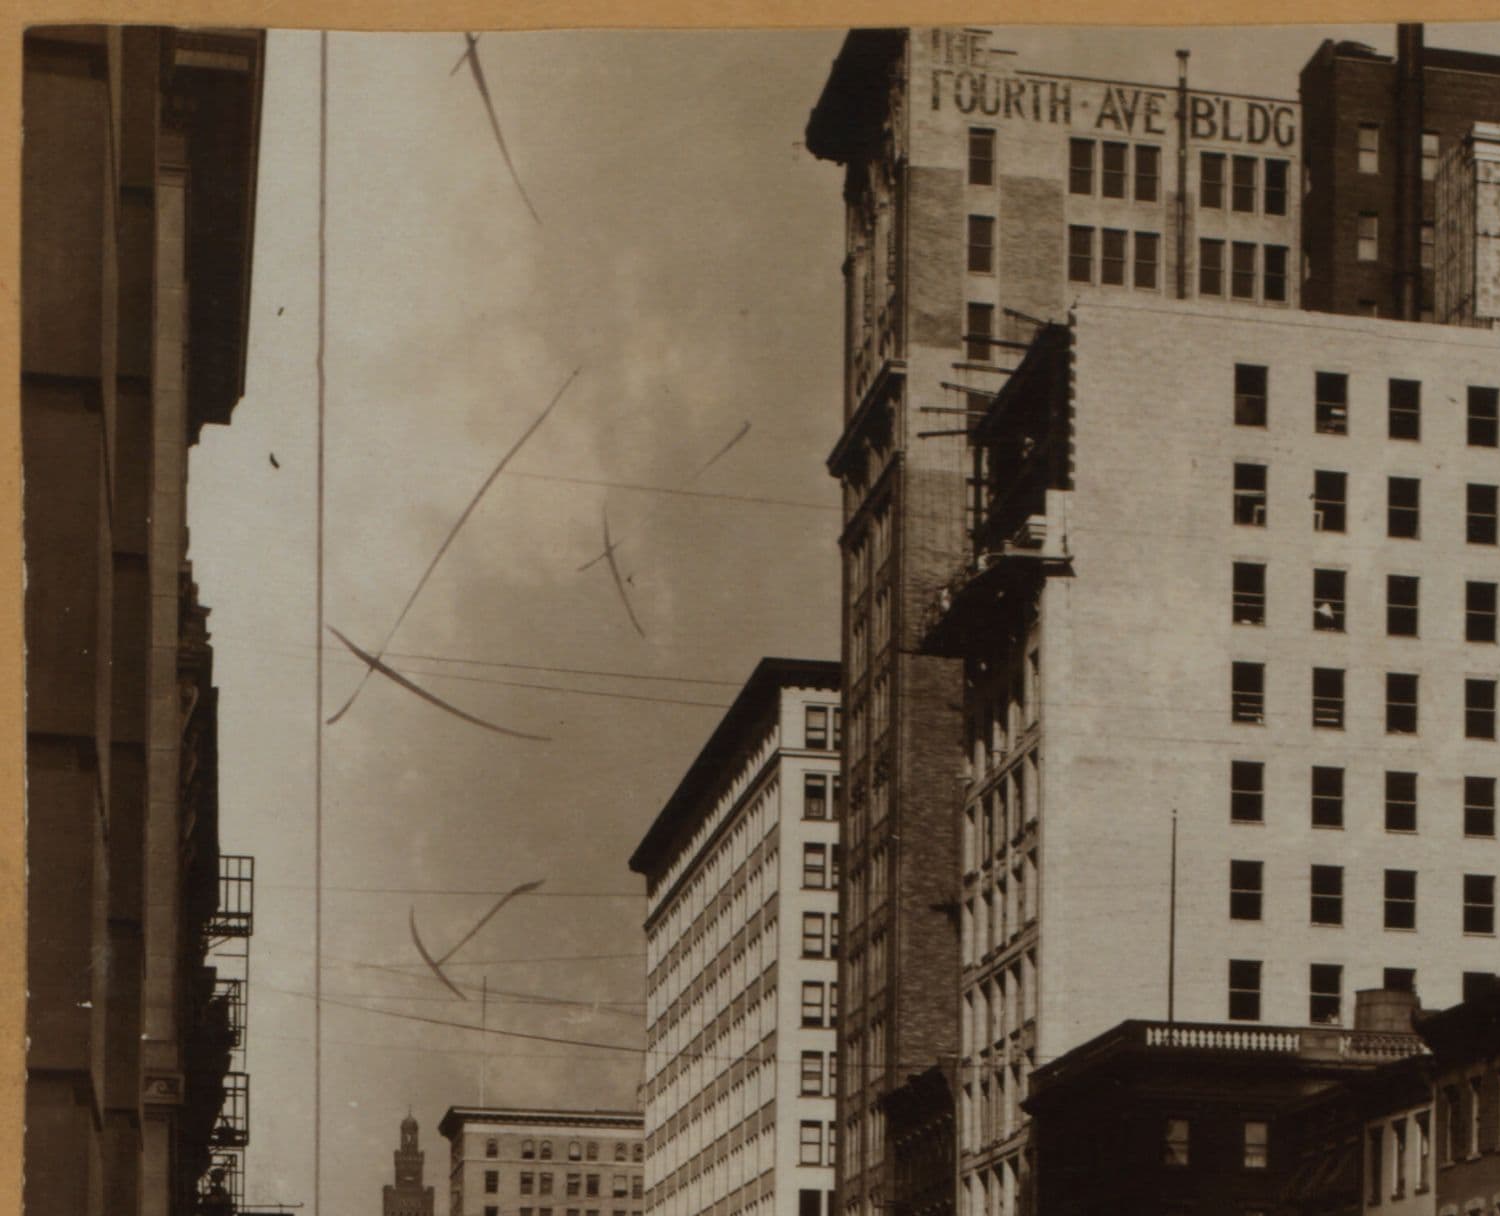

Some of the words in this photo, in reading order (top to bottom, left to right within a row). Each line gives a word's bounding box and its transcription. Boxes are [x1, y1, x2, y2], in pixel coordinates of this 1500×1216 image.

[931, 28, 988, 66] THE
[931, 69, 1073, 125] FOURTH
[1094, 84, 1167, 135] AVE
